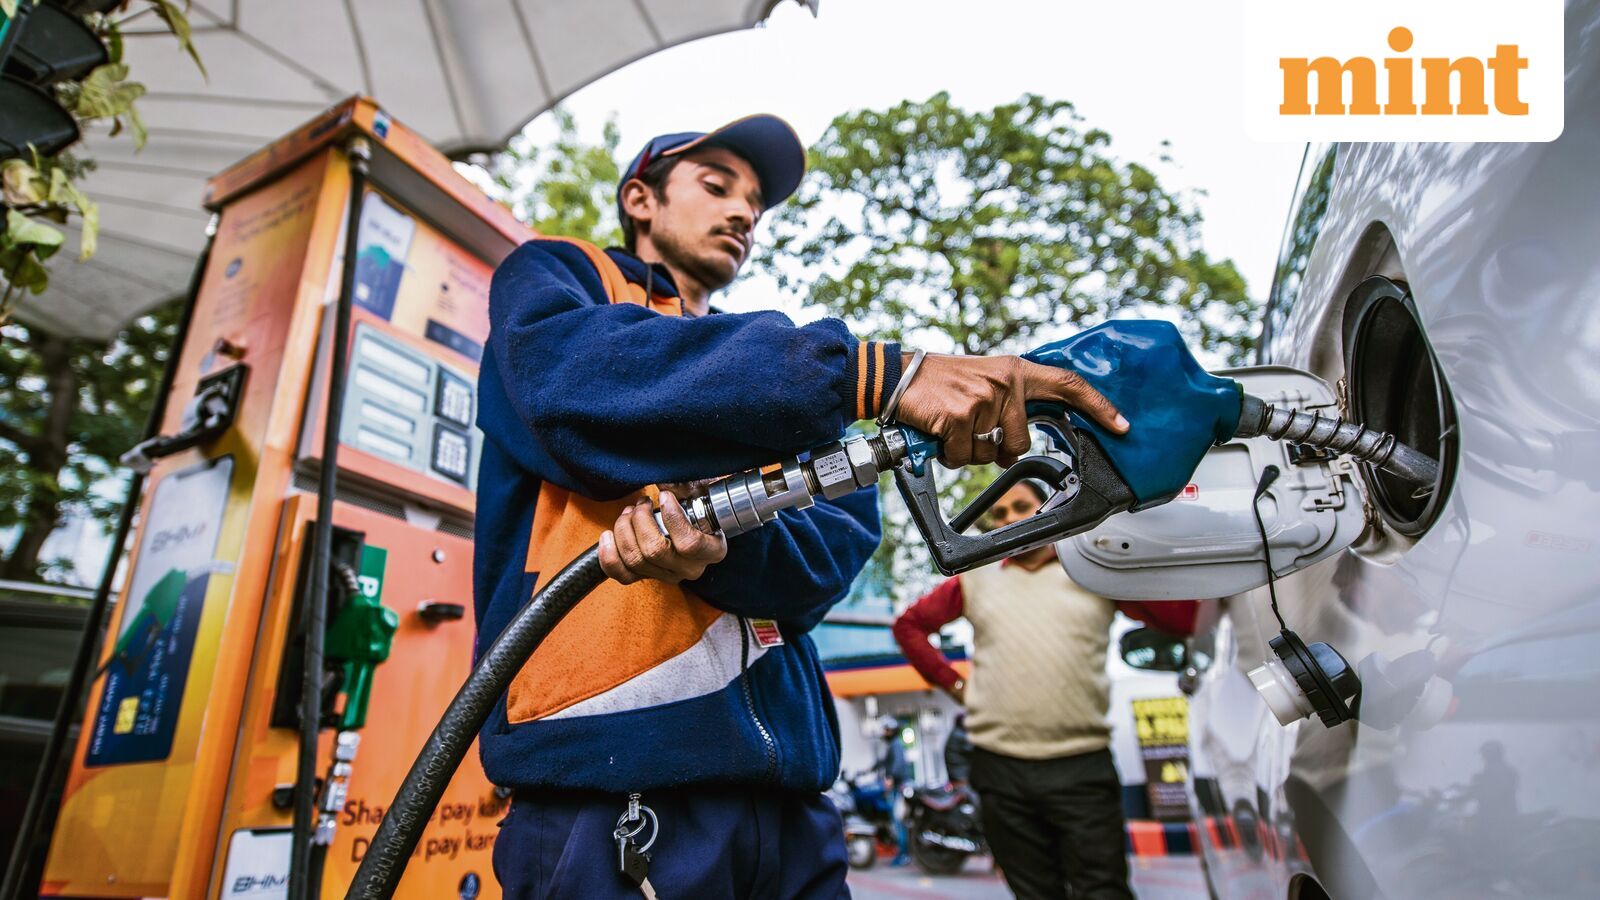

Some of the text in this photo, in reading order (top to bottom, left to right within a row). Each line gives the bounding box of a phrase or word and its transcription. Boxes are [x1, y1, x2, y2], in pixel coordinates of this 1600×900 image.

[440, 803, 475, 827] pay
[426, 838, 462, 863] pay
[369, 856, 395, 884] TYPE
